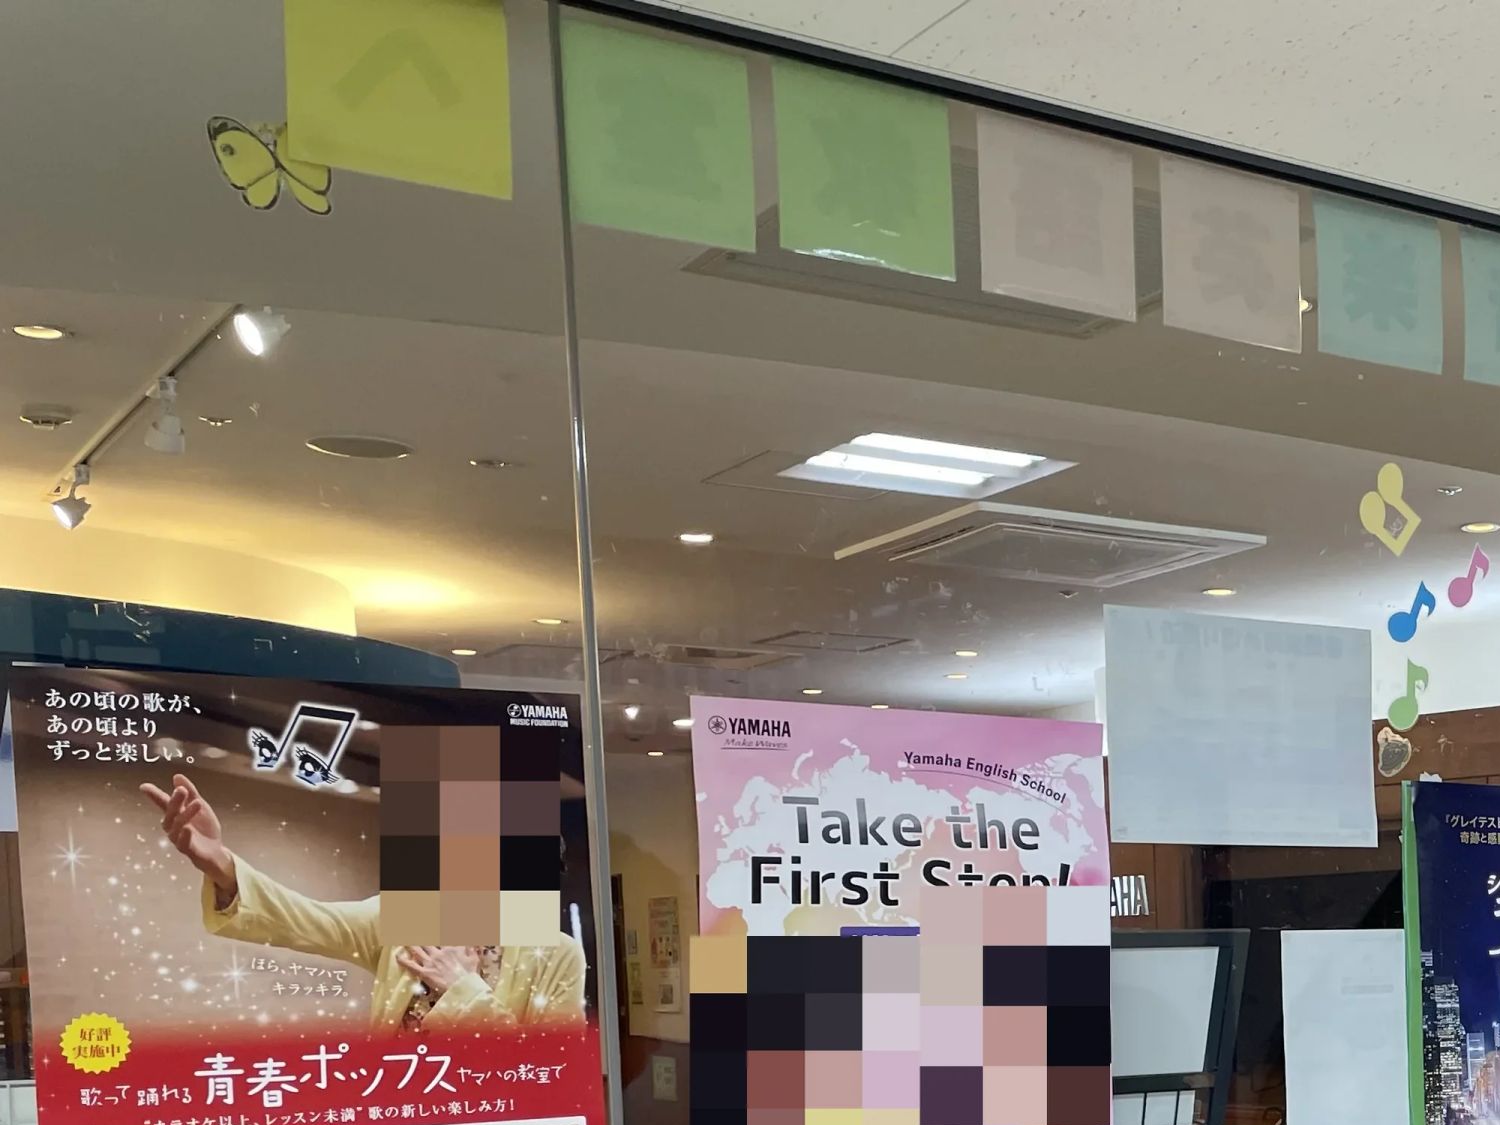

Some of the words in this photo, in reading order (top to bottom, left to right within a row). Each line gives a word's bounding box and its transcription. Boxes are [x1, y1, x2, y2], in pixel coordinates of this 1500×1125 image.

[44, 689, 202, 715] あの頃の歌が、
[521, 704, 567, 719] YAMAHA
[46, 714, 158, 738] あの頃より
[510, 718, 529, 727] MUSIC
[531, 719, 568, 728] FOUNDATION
[728, 716, 791, 738] YAMAHA
[47, 740, 197, 764] ずっと楽しい。
[903, 750, 962, 769] Yamaha
[966, 756, 1019, 783] English
[1021, 772, 1067, 804] School
[782, 795, 923, 847] Take
[945, 802, 1041, 851] the
[751, 855, 899, 906] First
[251, 956, 348, 982] ほら、ヤマハで
[272, 980, 350, 999] キラッキラ。
[79, 1027, 112, 1042] 好評
[73, 1044, 121, 1059] 実施中
[194, 1043, 457, 1108] 青春ポップス
[457, 1062, 567, 1086] ヤマハの教室で
